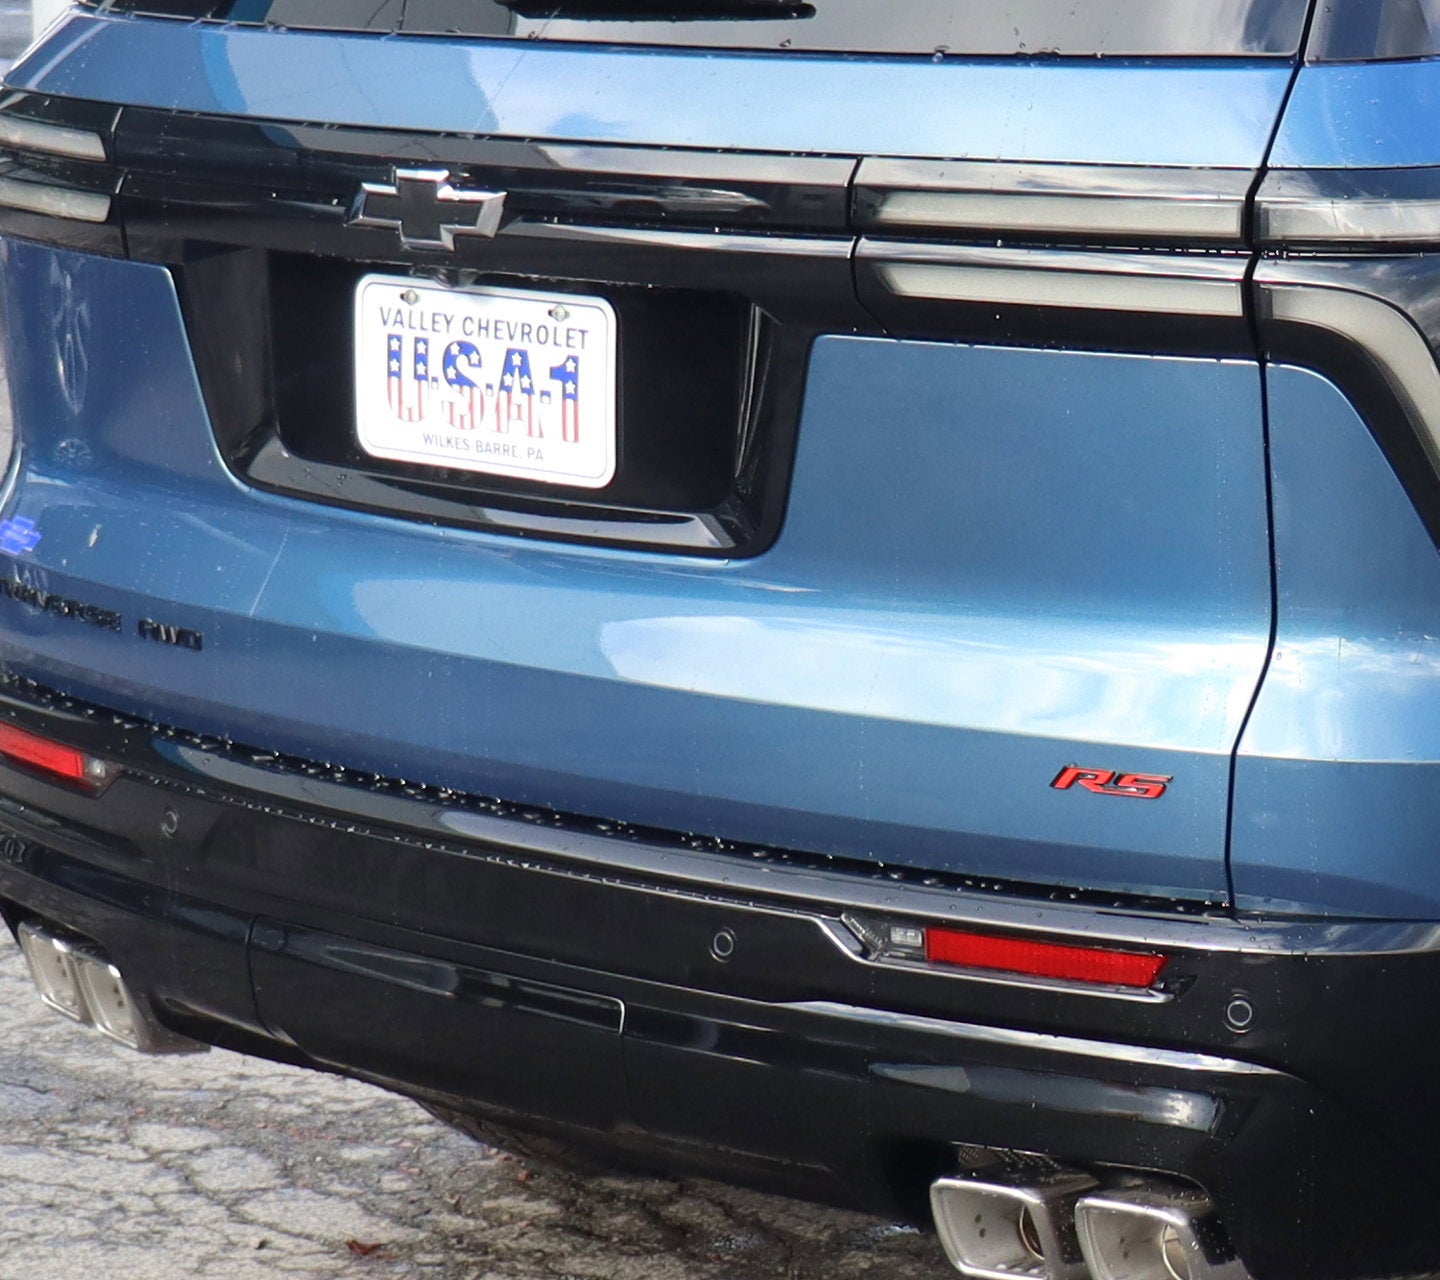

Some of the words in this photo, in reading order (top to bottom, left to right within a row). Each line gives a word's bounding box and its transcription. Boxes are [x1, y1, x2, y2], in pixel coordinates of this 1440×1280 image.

[378, 305, 455, 334] VALLEY
[461, 315, 589, 350] CHEVROLET
[526, 447, 544, 461] PA
[1048, 764, 1174, 800] RS
